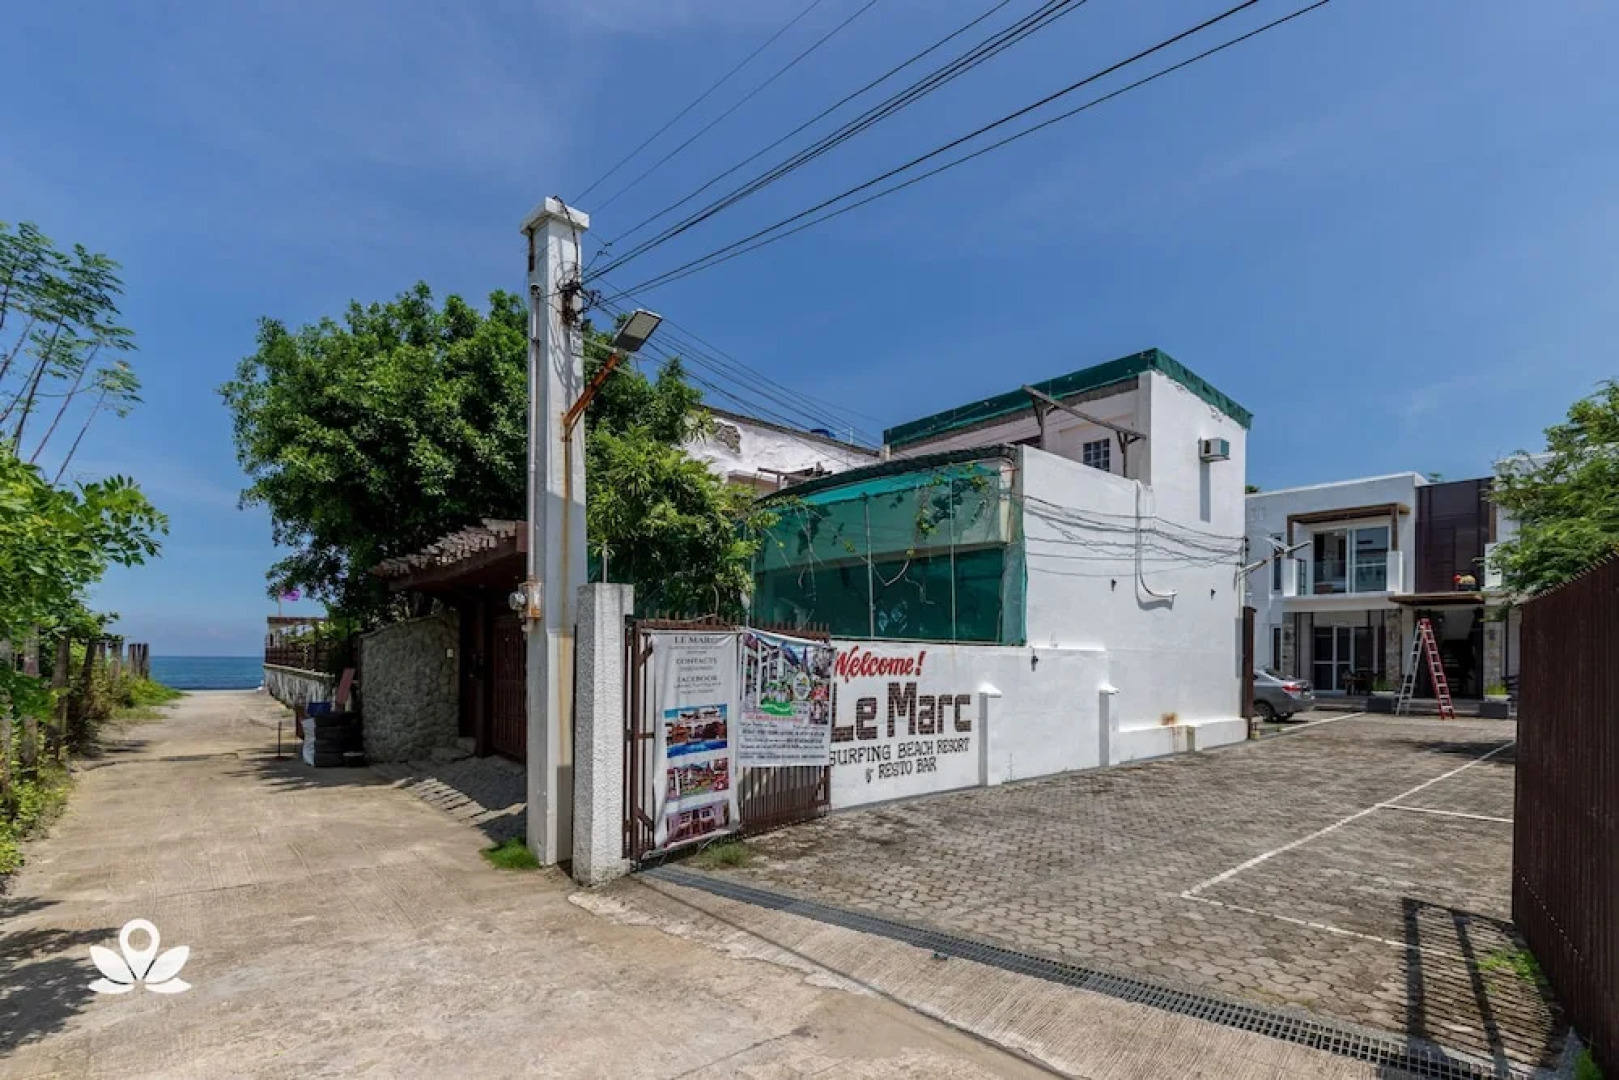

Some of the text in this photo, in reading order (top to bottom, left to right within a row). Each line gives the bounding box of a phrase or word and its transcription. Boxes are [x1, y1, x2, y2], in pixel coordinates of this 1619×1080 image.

[834, 645, 926, 683] Welcome!
[830, 682, 878, 744] Le
[887, 682, 972, 738] Marc
[829, 737, 970, 767] SURFING BEACH RESORT
[878, 760, 913, 780] RESTO
[916, 756, 937, 774] BAR
